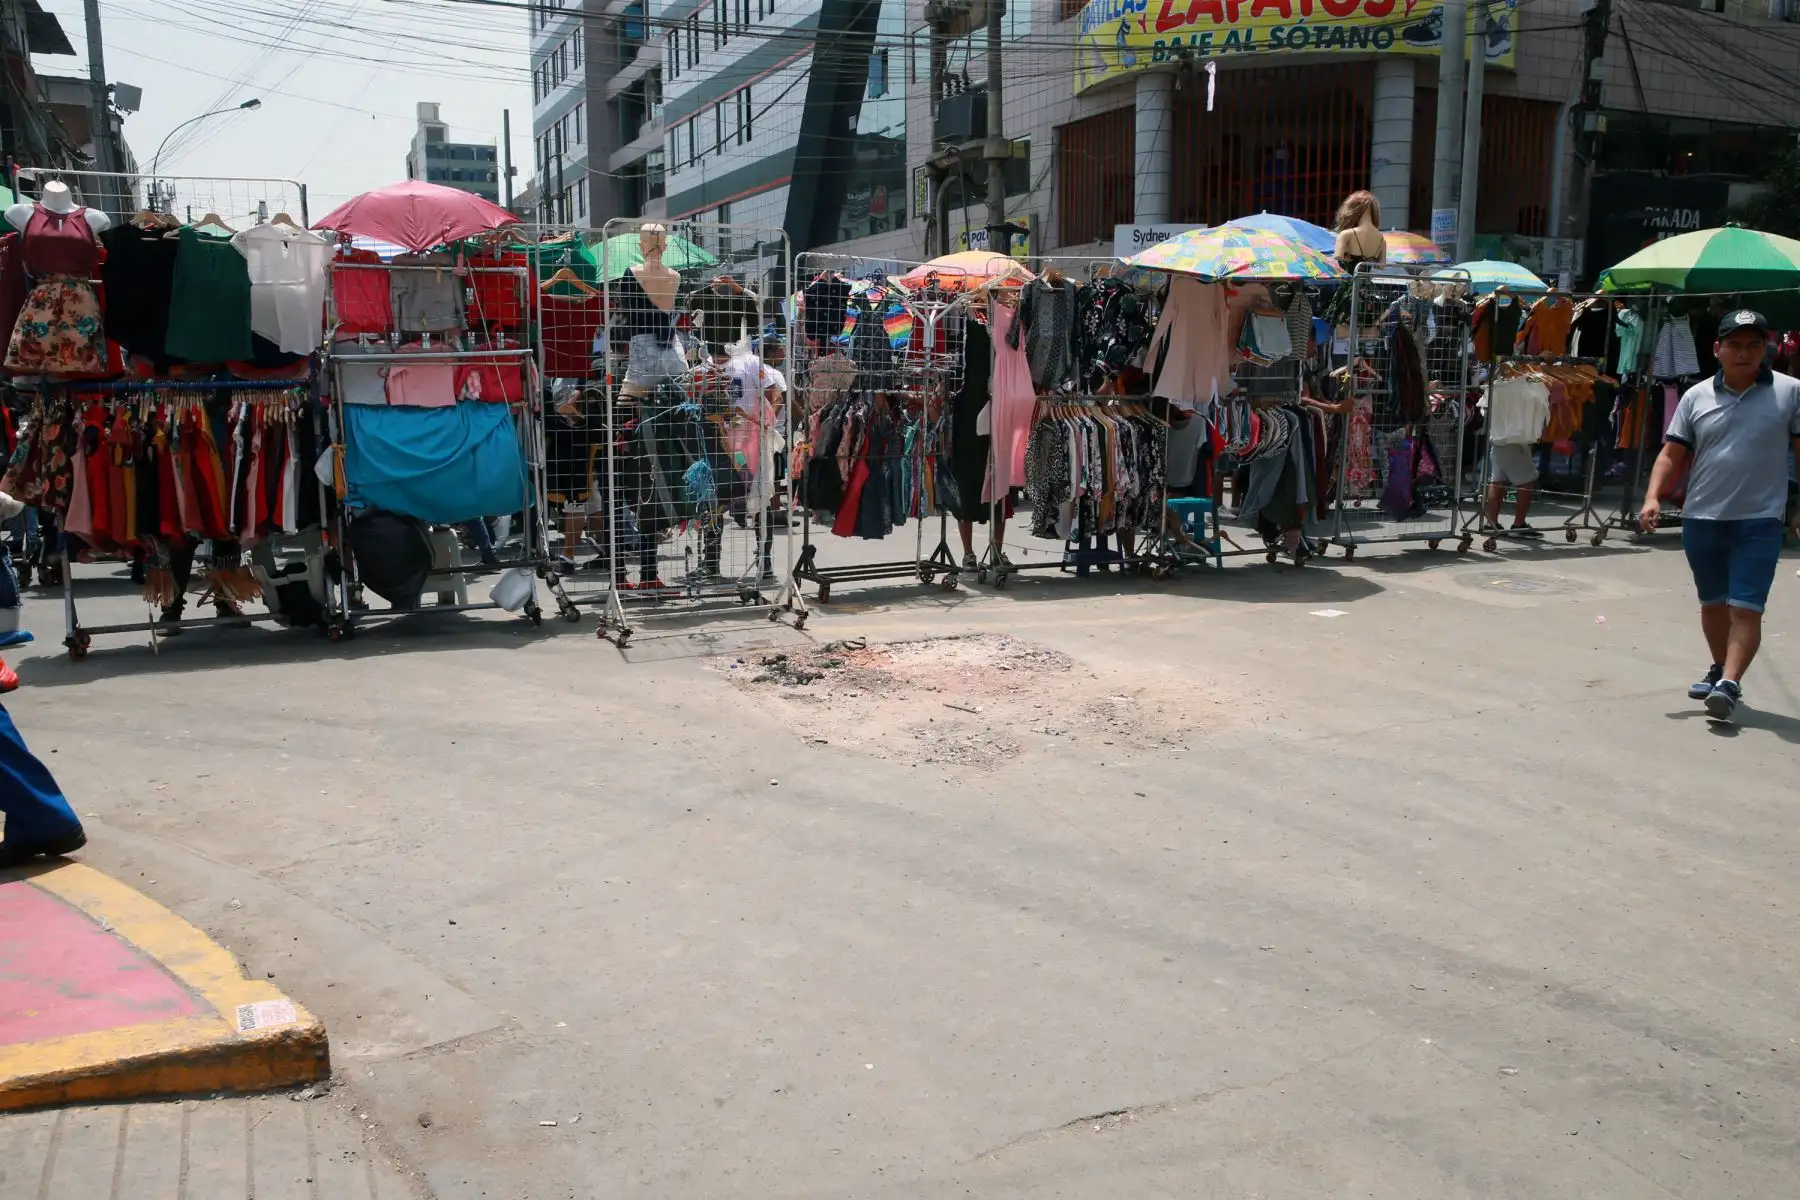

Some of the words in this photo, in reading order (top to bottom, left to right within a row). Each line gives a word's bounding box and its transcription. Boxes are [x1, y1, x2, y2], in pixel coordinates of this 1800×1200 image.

[1219, 27, 1257, 54] AL
[1268, 18, 1395, 50] SÓTANO
[1133, 227, 1171, 245] Sydney
